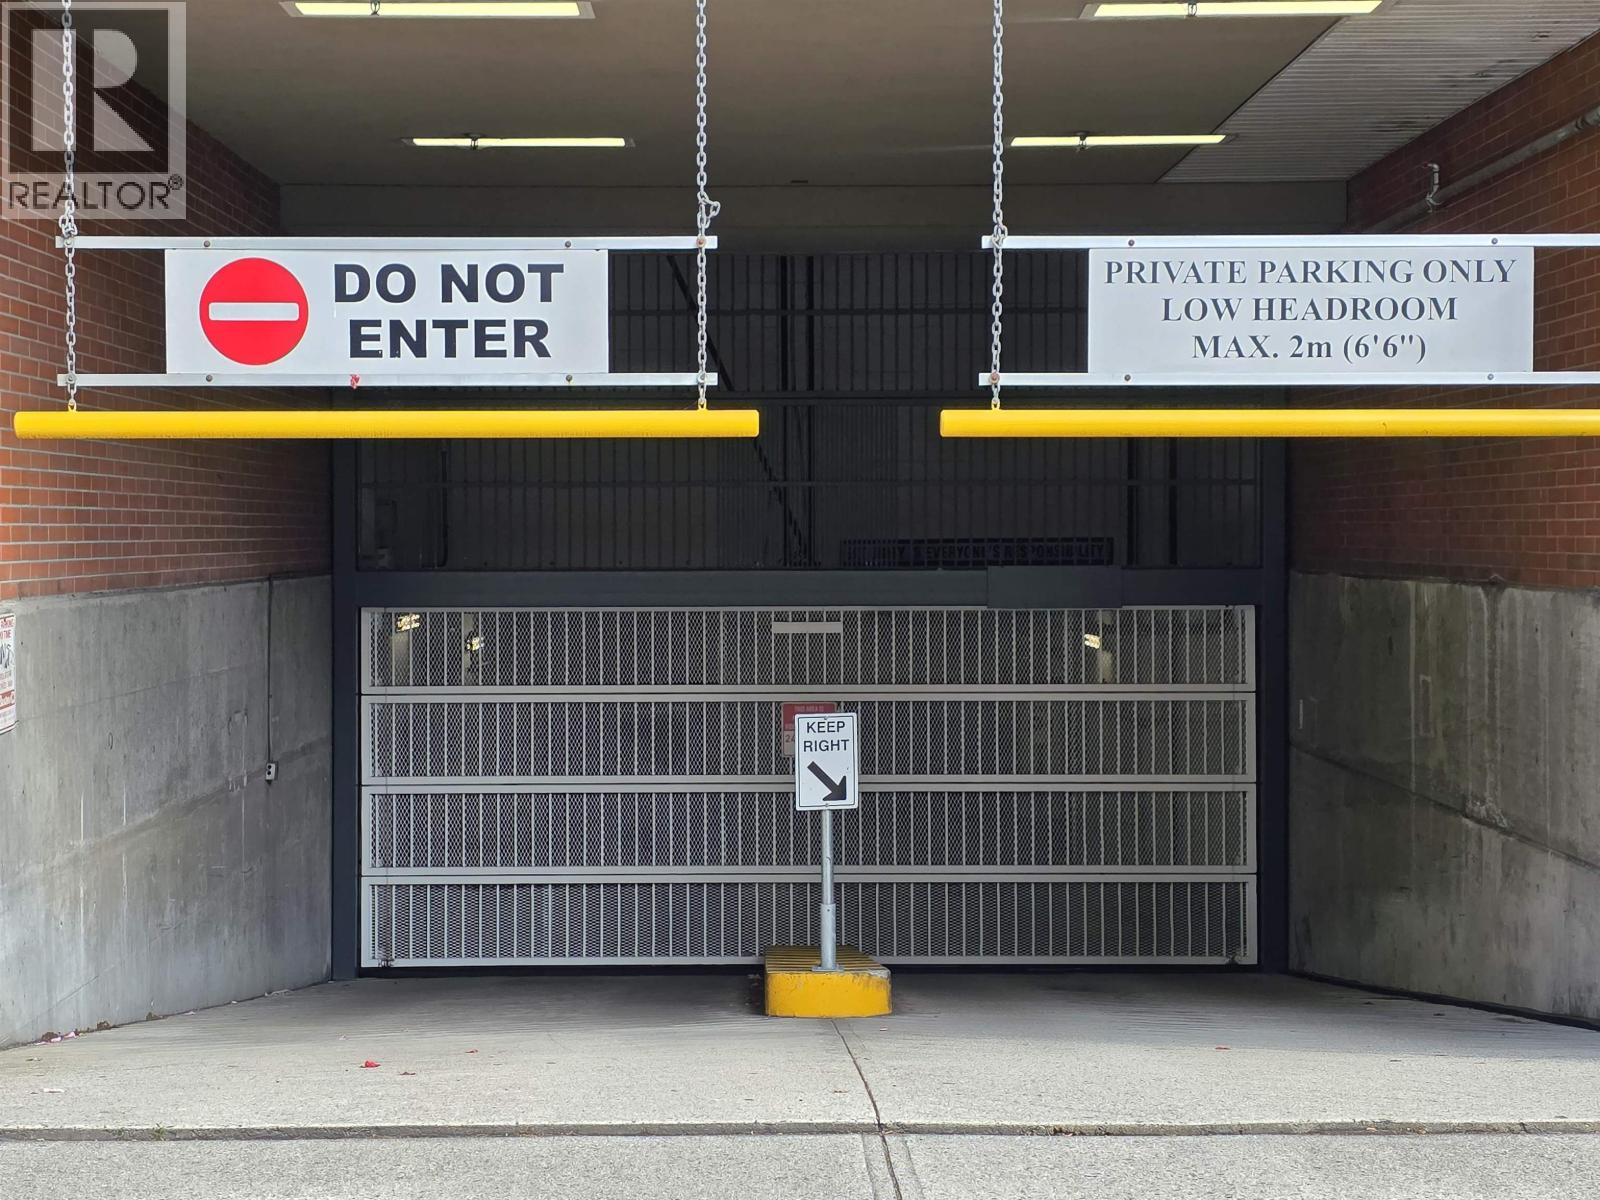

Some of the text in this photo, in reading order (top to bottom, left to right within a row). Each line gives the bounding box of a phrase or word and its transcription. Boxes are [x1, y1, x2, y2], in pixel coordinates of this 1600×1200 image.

[335, 263, 564, 304] DO NOT
[1105, 259, 1516, 284] PRIVATE PARKING ONLY
[1162, 298, 1457, 322] LOW HEADROOM
[349, 319, 552, 359] ENTER
[1192, 334, 1427, 364] MAX. 2m (6'6")
[806, 720, 846, 734] KEEP
[803, 738, 850, 753] RIGHT
